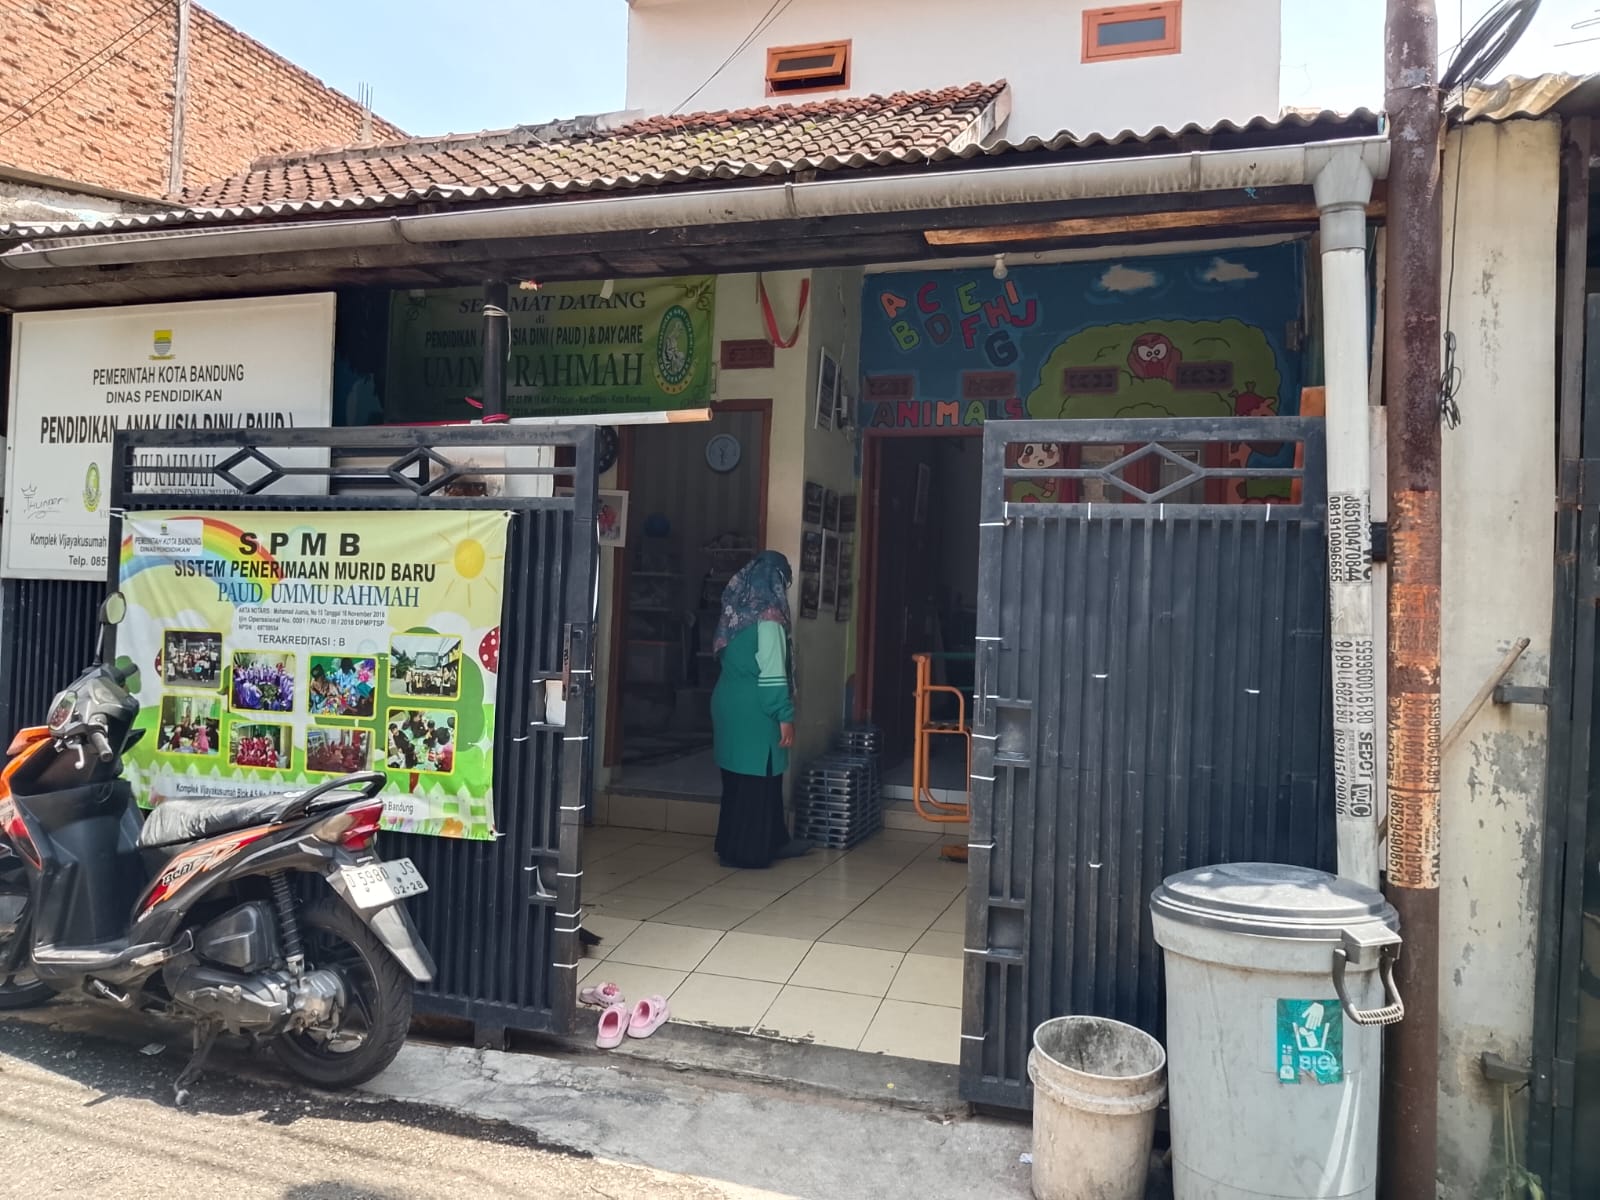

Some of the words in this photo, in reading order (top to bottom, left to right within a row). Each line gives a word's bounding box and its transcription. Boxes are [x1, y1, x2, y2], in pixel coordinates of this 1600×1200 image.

[459, 295, 555, 314] SEMAT
[558, 292, 646, 310] DATANG
[881, 292, 906, 318] A
[917, 281, 938, 313] C
[957, 280, 981, 313] E
[1004, 280, 1021, 304] I
[536, 315, 545, 324] di
[984, 296, 1011, 328] H
[1010, 299, 1037, 328] J
[425, 330, 476, 348] PENDIDIKAN
[530, 328, 549, 345] DINI
[557, 328, 580, 345] PAUD
[589, 329, 596, 342] &
[598, 326, 617, 344] DAY
[618, 325, 643, 344] CARE
[889, 320, 921, 350] B
[924, 313, 952, 345] D
[961, 314, 985, 348] F
[984, 330, 1018, 367] G
[93, 367, 155, 385] PEMERINTAH
[158, 366, 187, 383] KOTA
[190, 364, 244, 382] BANDUNG
[423, 356, 485, 387] UMM
[514, 353, 645, 387] RAHMAH
[106, 390, 141, 404] DINAS
[145, 389, 222, 402] PENDIDIKAN
[872, 398, 1026, 427] ANIMALS
[40, 415, 118, 443] PENDIDIKAN
[30, 532, 57, 548] Komplek
[1329, 496, 1342, 582] 081910096655
[69, 555, 88, 567] Telp.
[91, 556, 107, 567] 085
[174, 559, 226, 577] SISTEM
[230, 560, 329, 580] PENERIMAAN
[335, 561, 386, 580] MURID
[391, 562, 435, 582] BARU
[217, 582, 263, 603] PAUD
[270, 583, 333, 605] UMMU
[333, 584, 420, 608] RAHMAH
[258, 634, 330, 646] TERAKREDITASI
[339, 637, 346, 646] B
[1356, 640, 1374, 724] 081910096655
[1358, 732, 1373, 780] SEDOT
[176, 783, 199, 794] Komplek
[1350, 783, 1372, 818] WC
[388, 801, 414, 815] Bandung
[400, 861, 415, 875] JS
